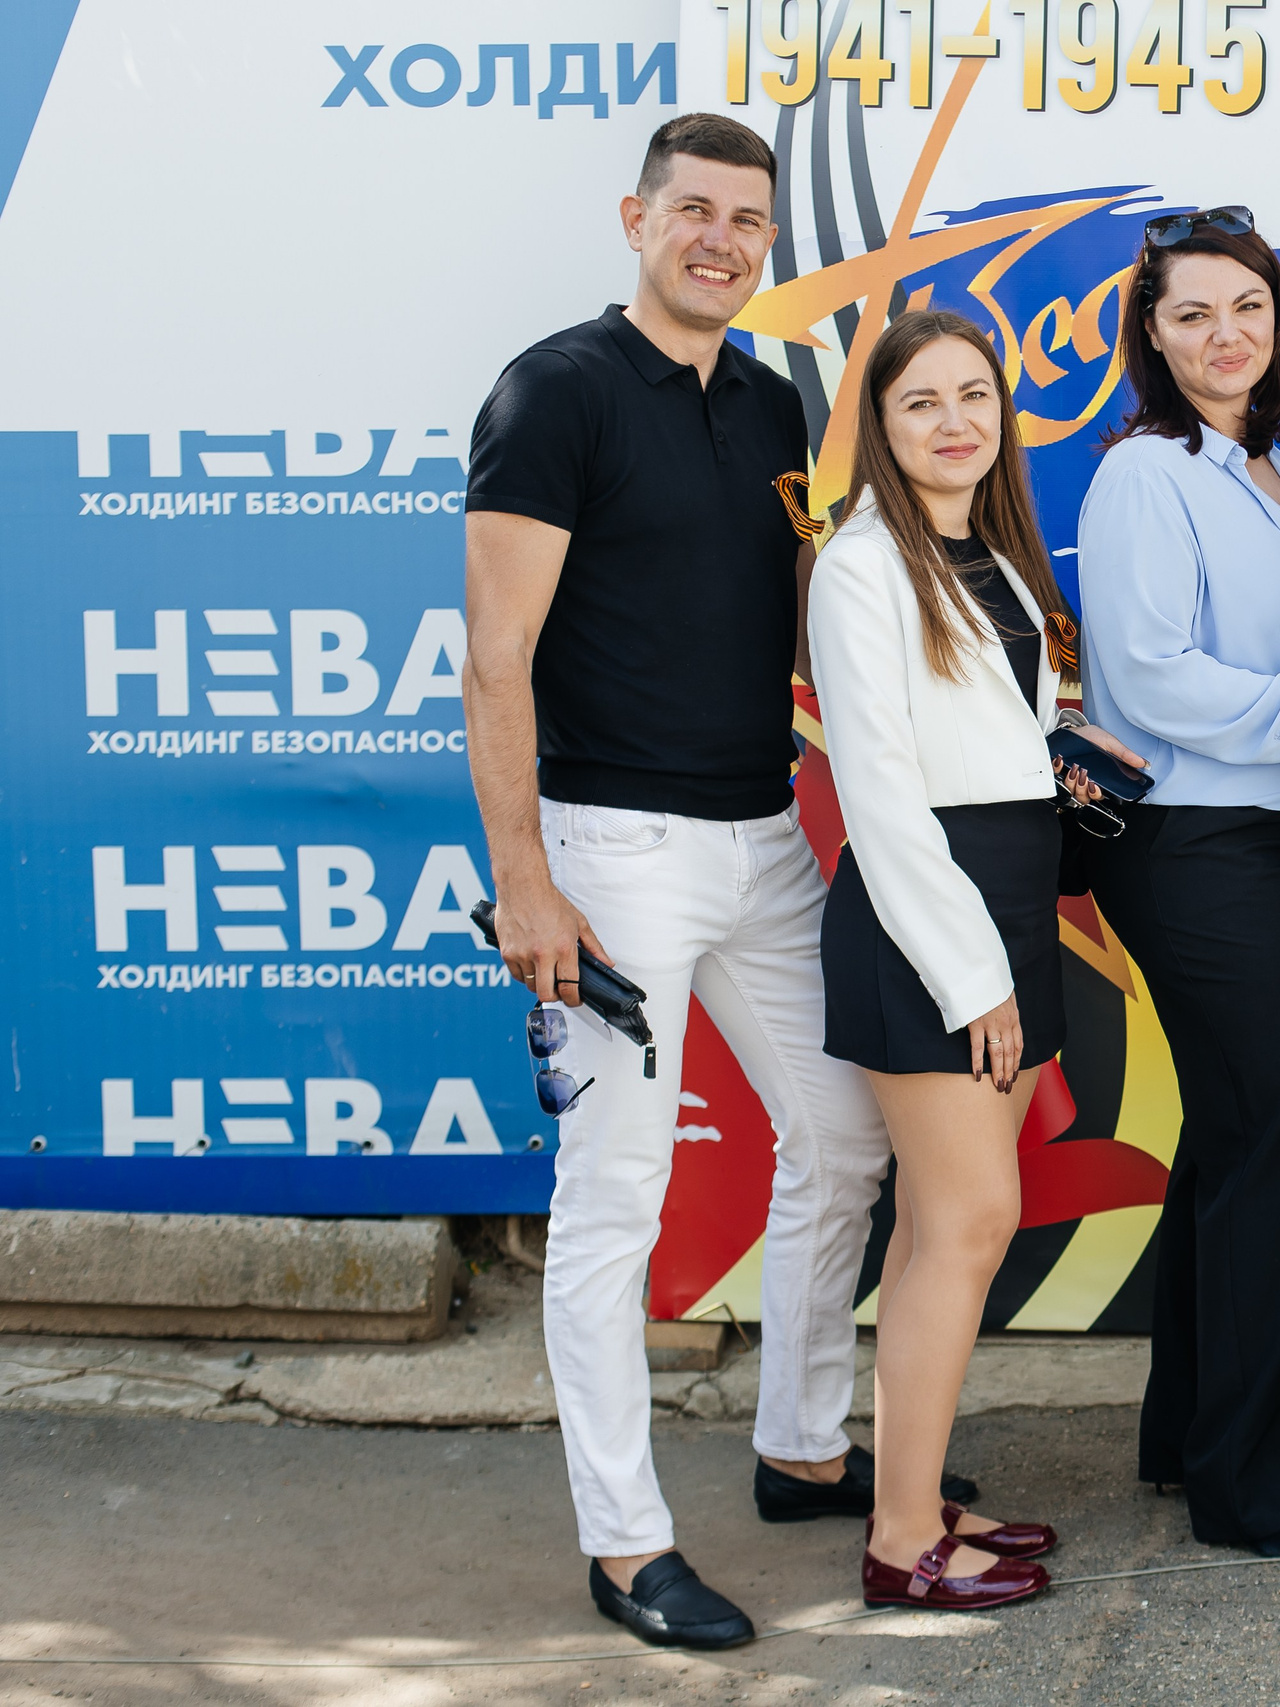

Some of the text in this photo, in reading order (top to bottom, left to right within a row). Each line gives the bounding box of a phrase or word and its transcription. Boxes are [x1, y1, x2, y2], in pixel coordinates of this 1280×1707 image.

[323, 42, 677, 119] ХОЛДИ
[79, 492, 237, 519] ХОЛДИНГ
[84, 609, 468, 716] НЕВА
[87, 730, 467, 758] ХОЛДИНГ БЕЗОПАСНОС
[92, 845, 501, 951] НЕВА
[98, 963, 512, 992] ХОЛДИНГ БЕЗОПАСНОСТИ
